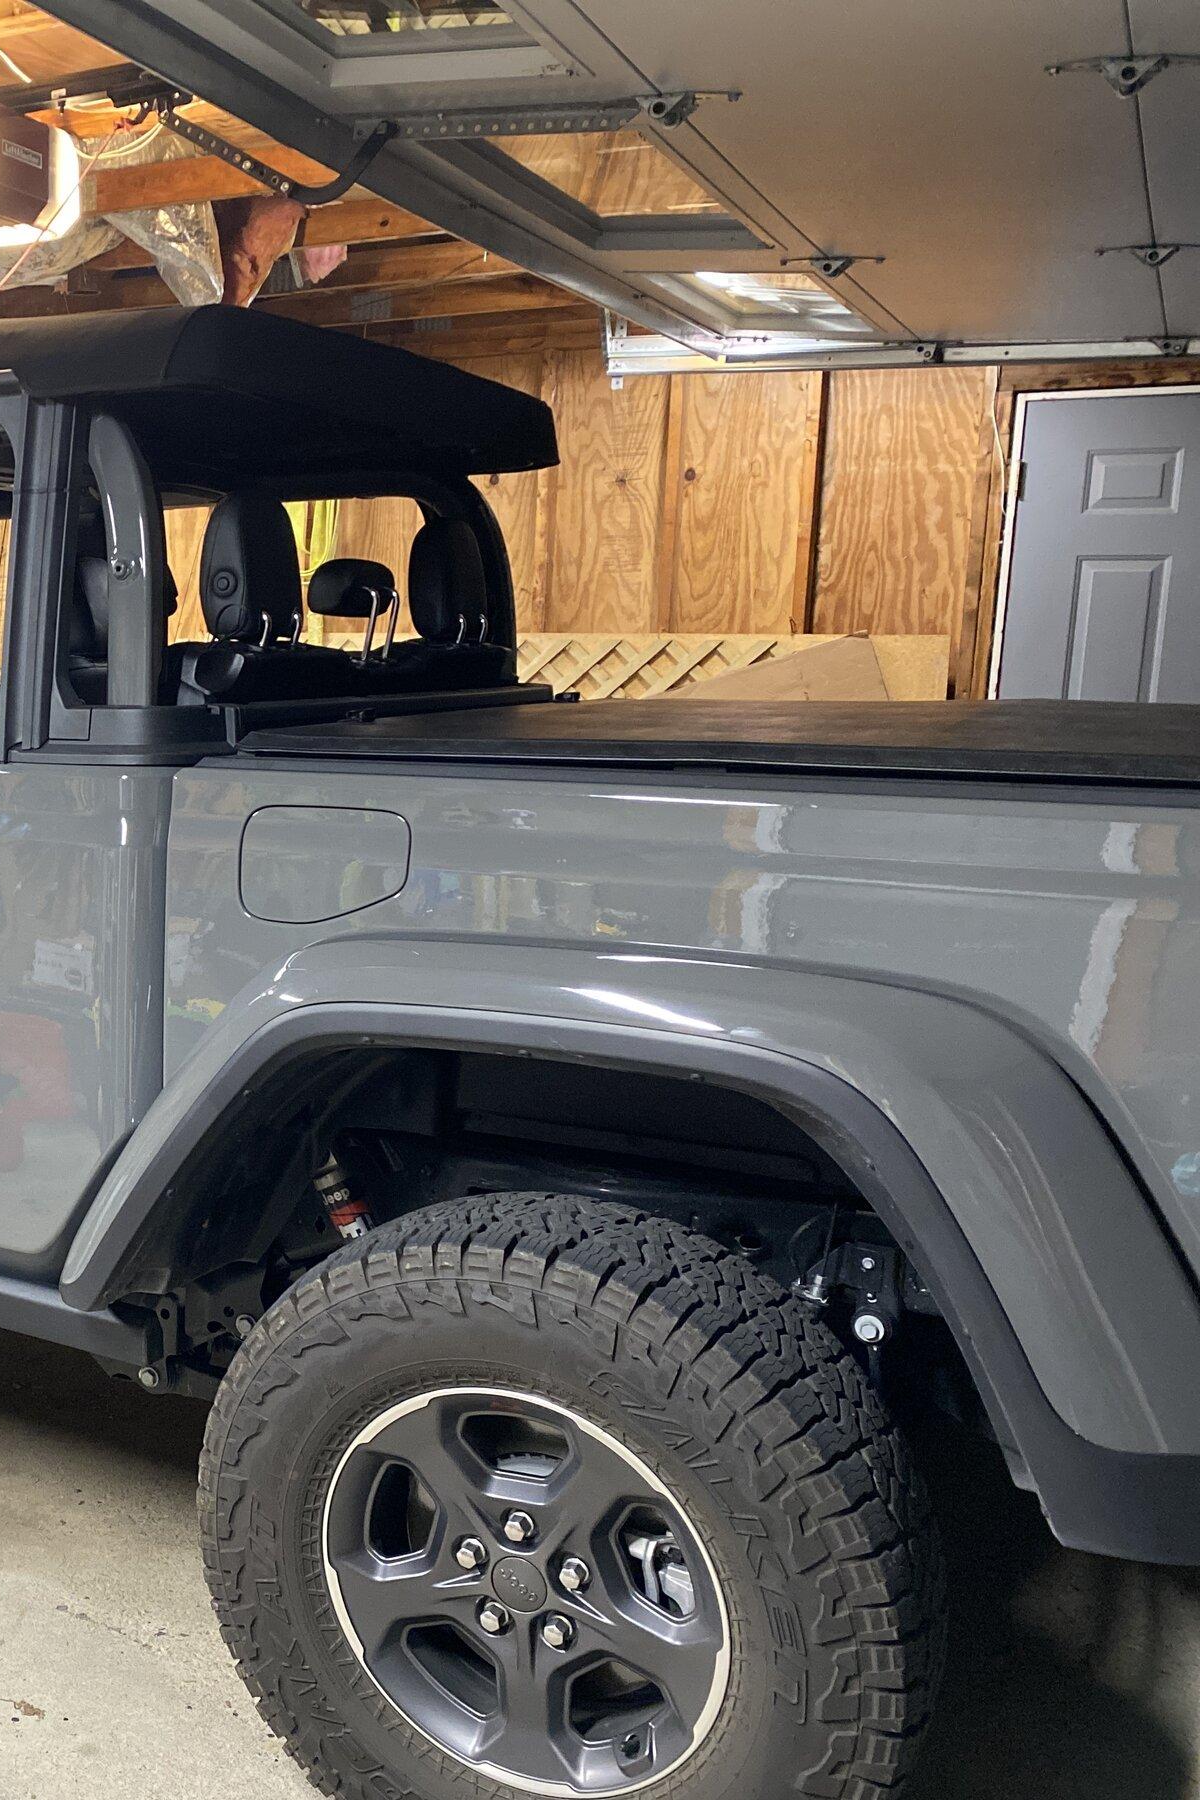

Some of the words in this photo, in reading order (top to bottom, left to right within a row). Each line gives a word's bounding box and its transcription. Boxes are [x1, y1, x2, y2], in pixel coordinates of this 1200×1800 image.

[321, 1188, 350, 1206] Jeep
[586, 1366, 811, 1727] FALKEN
[499, 1568, 539, 1603] Jeep
